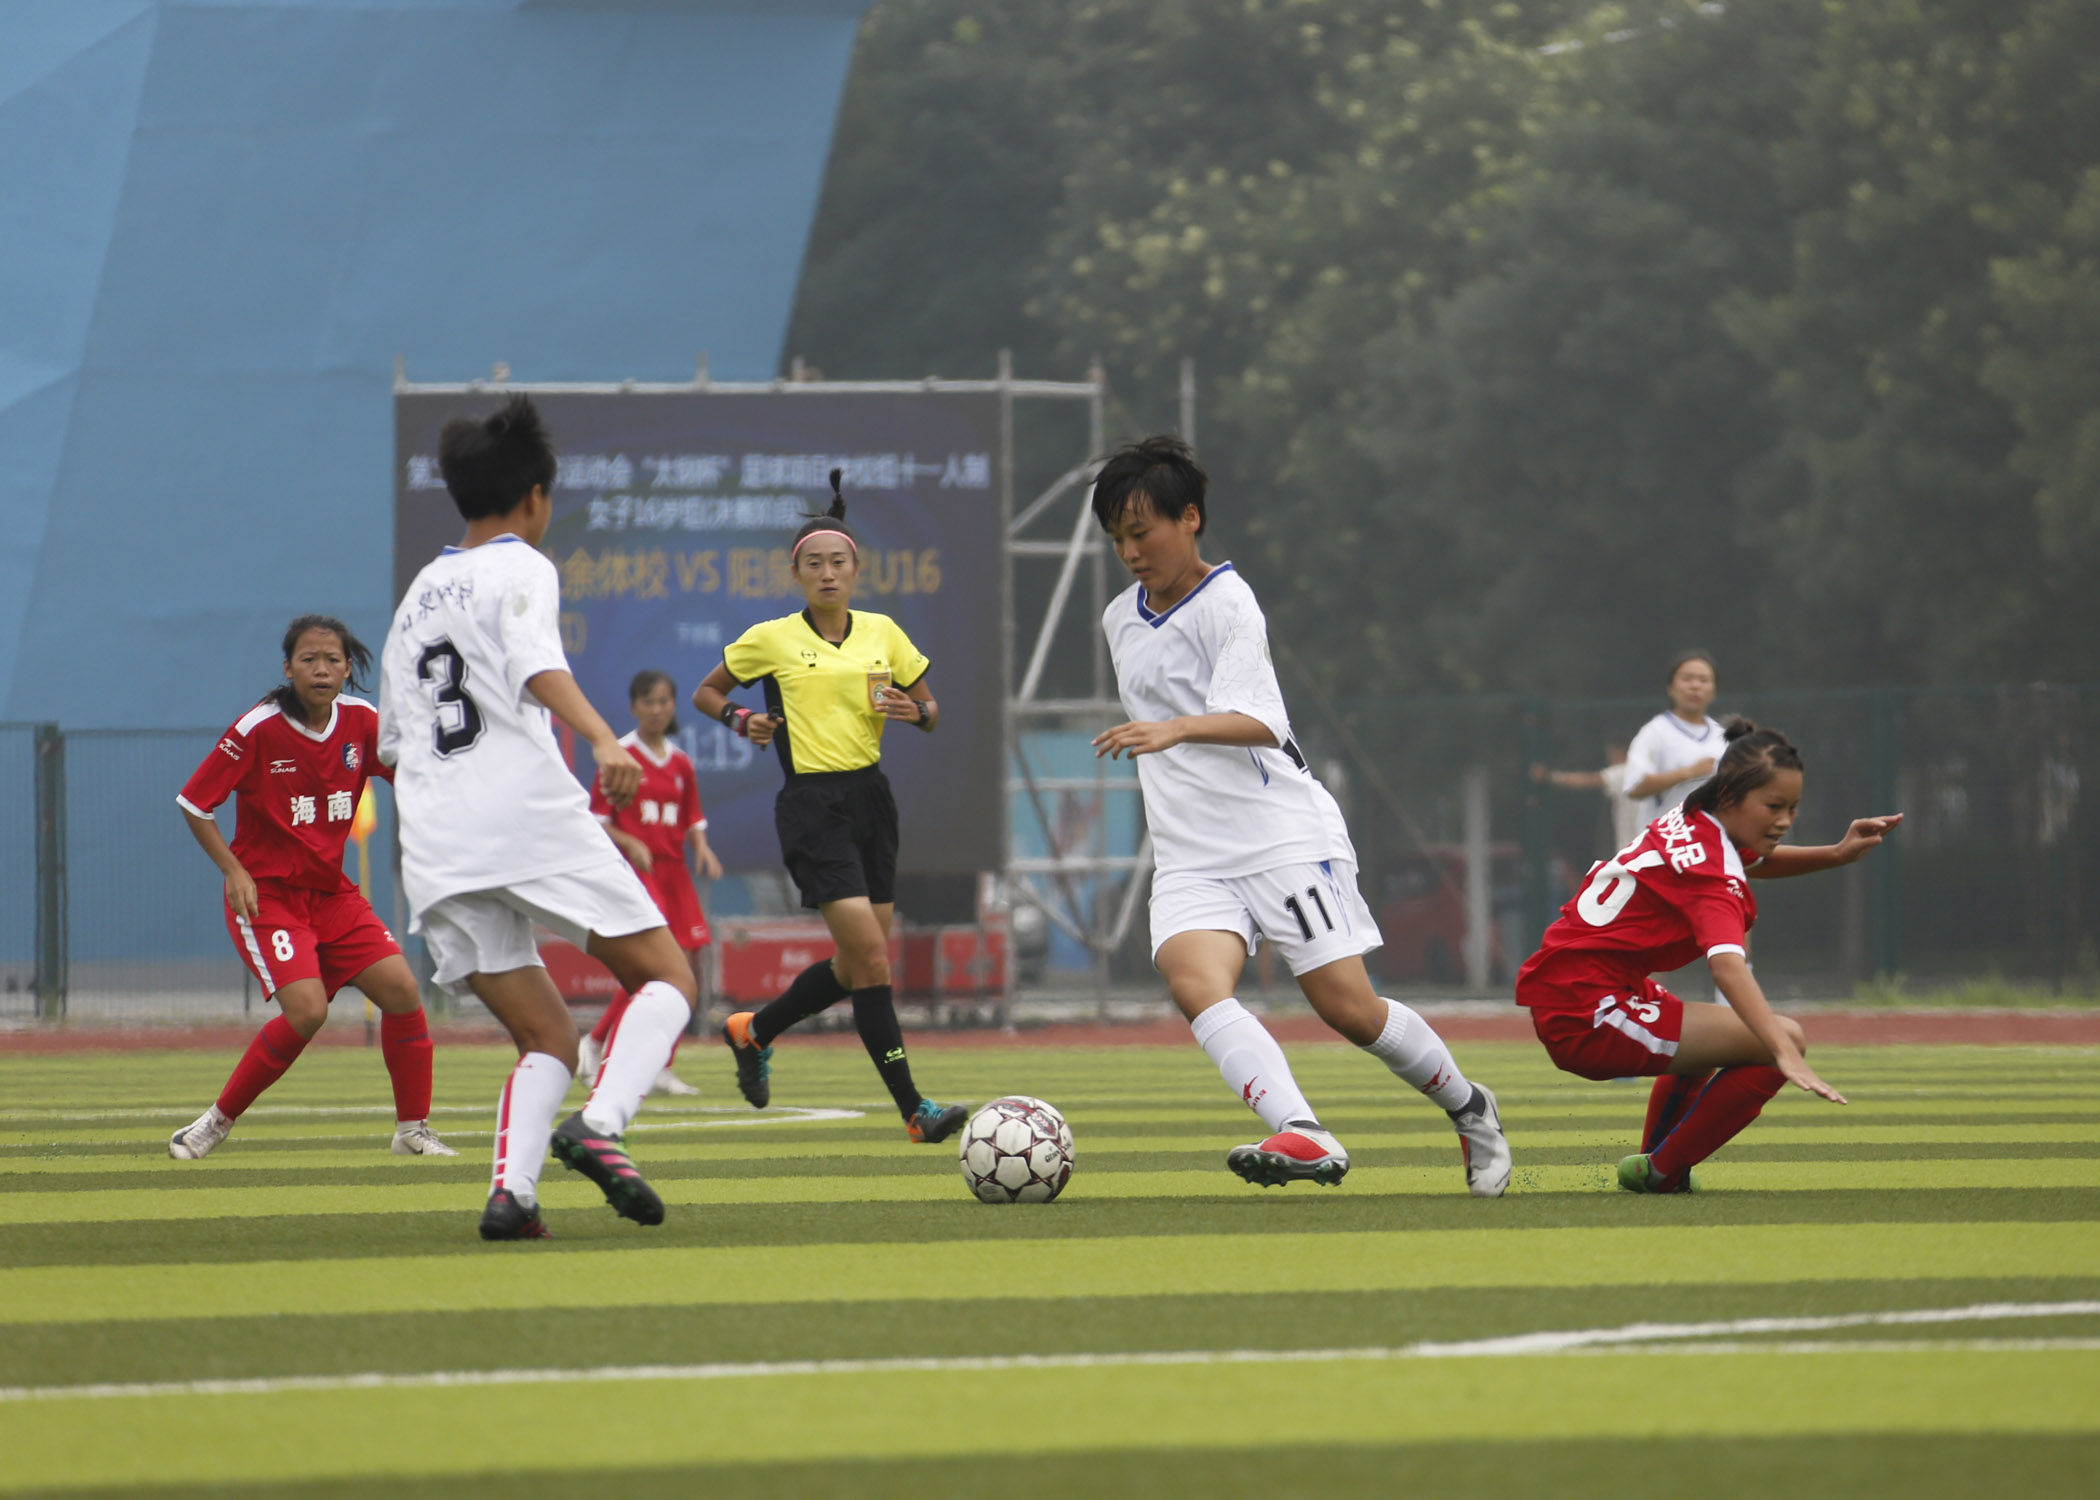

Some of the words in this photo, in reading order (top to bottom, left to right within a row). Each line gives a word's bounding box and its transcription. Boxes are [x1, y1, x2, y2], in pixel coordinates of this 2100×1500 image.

[551, 546, 669, 602] 余体校
[675, 549, 721, 593] VS
[412, 633, 487, 760] 3
[290, 790, 353, 827] 海南
[1284, 885, 1336, 943] 11
[271, 929, 294, 962] 8
